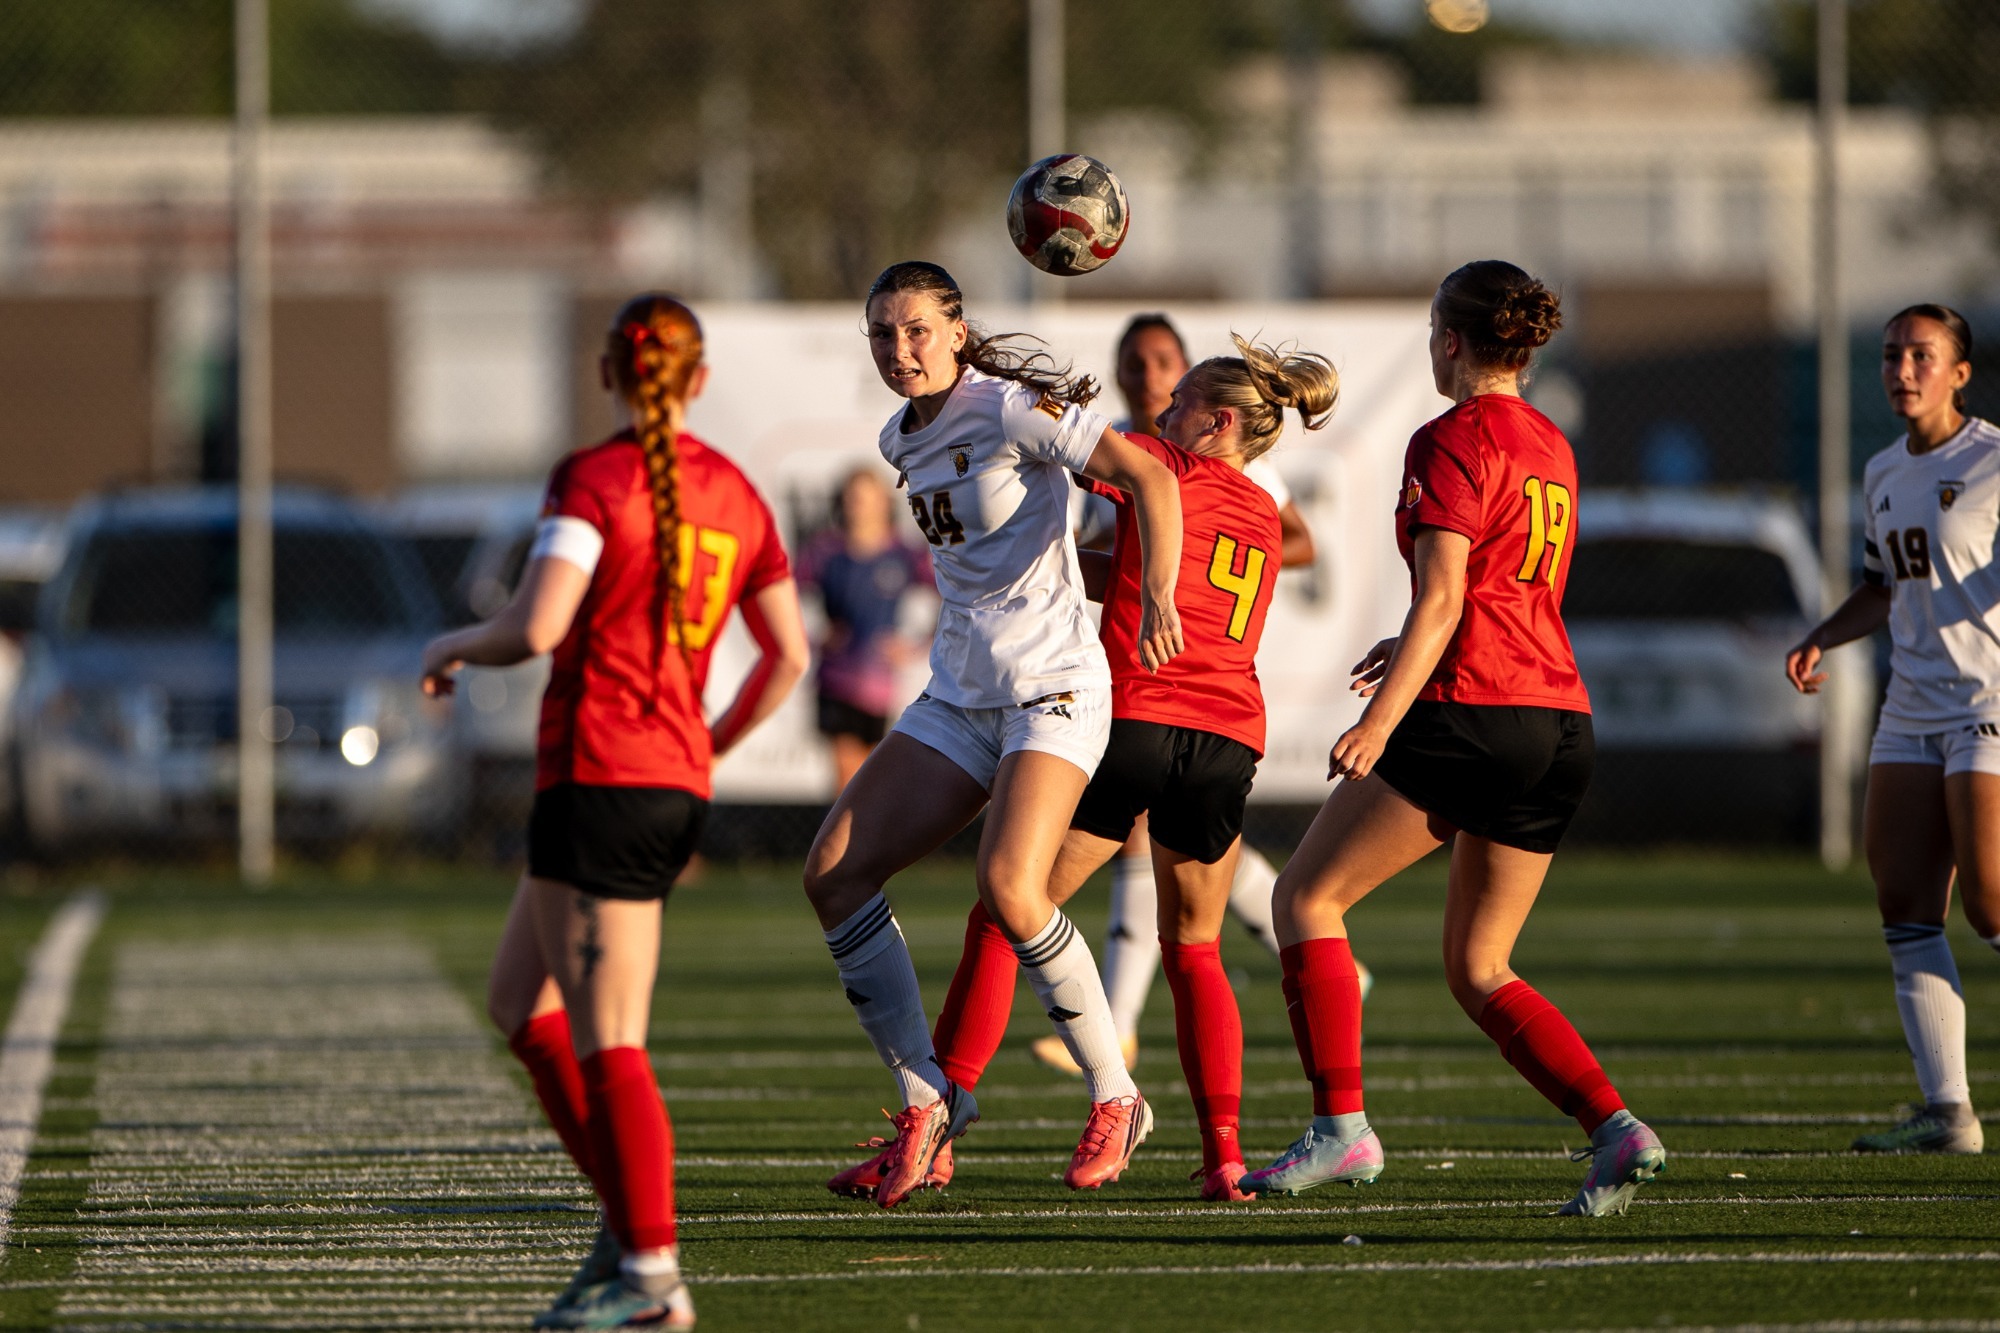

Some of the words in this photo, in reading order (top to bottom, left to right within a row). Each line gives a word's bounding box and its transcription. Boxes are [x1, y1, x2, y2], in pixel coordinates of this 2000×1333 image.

[949, 446, 974, 462] BISONS
[911, 491, 966, 546] 24
[1516, 475, 1571, 593] 19
[1885, 526, 1931, 580] 19
[1206, 531, 1267, 644] 4
